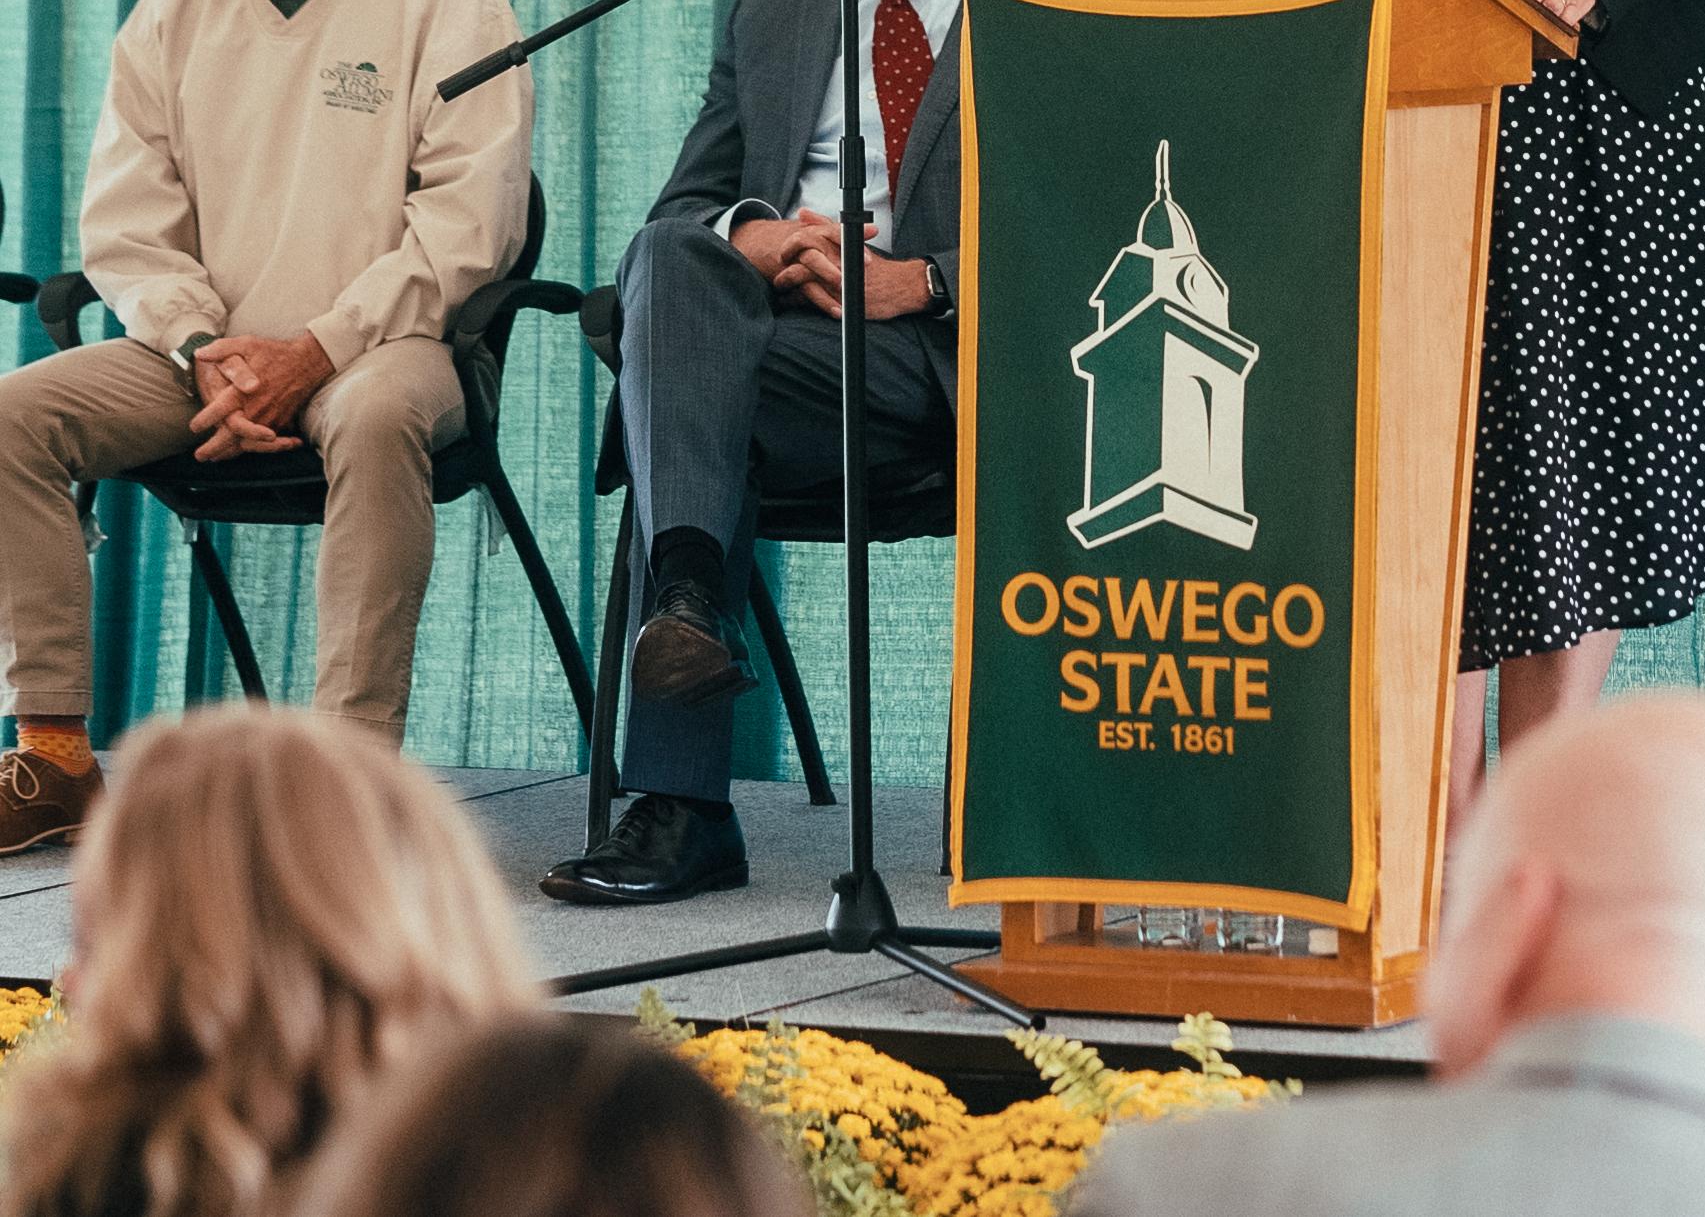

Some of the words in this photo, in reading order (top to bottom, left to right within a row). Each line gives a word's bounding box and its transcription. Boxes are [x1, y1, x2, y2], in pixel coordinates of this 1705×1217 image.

[1001, 572, 1325, 648] OSWEGO
[1060, 649, 1271, 720] STATE
[1099, 720, 1156, 751] EST.
[1171, 724, 1234, 755] 1861
